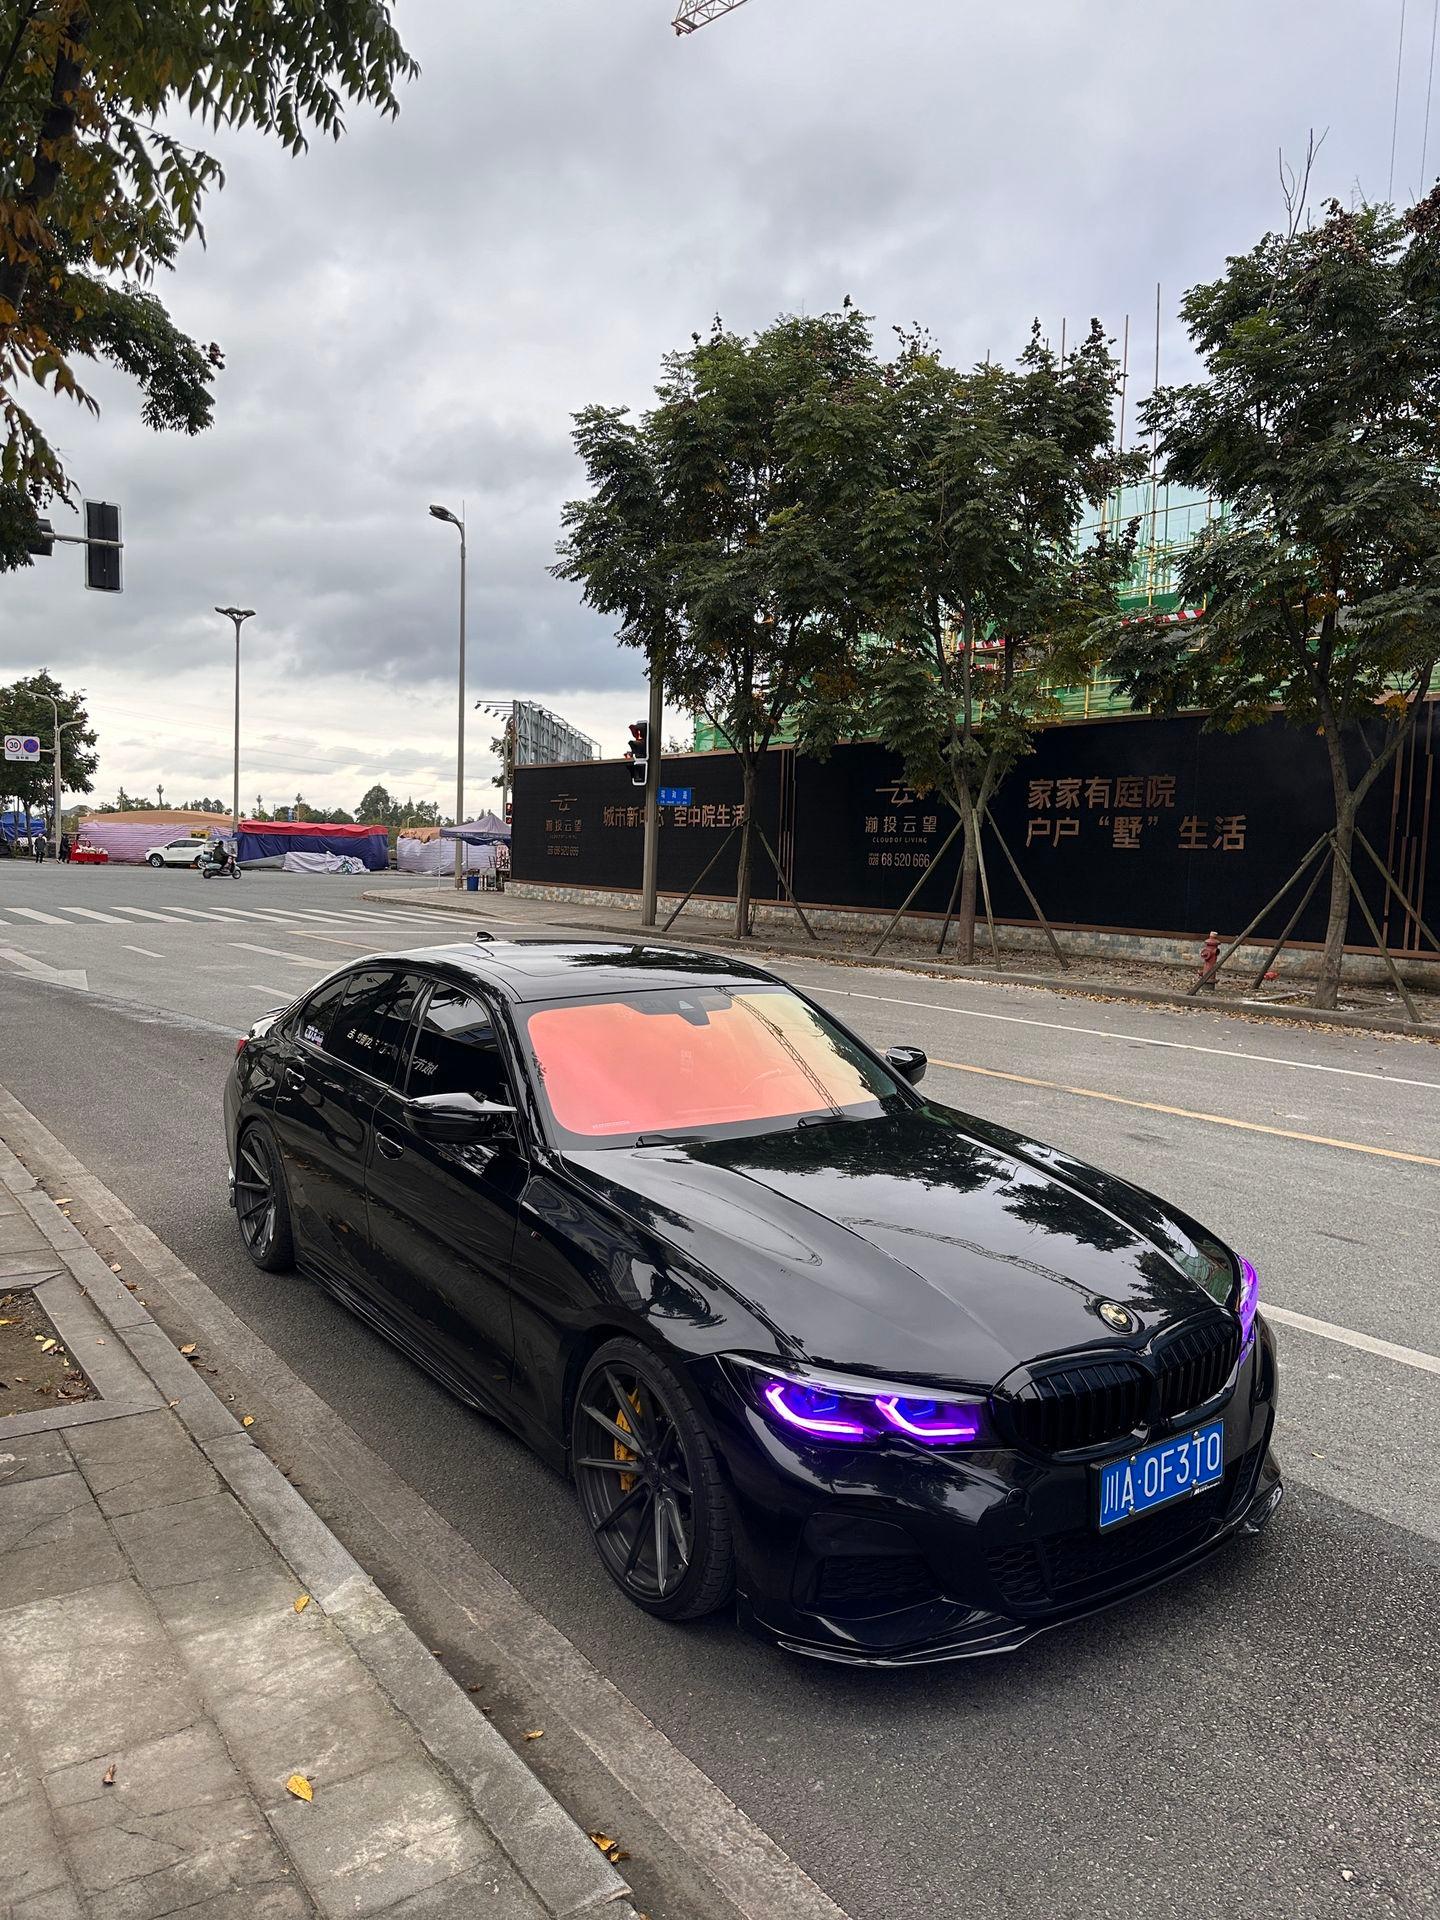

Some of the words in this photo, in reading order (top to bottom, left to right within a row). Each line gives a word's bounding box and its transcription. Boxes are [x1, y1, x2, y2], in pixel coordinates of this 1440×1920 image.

[1027, 774, 1177, 810] 家家有庭院
[673, 803, 745, 828] 空中院生活
[881, 852, 893, 867] 68
[894, 853, 911, 867] 520
[912, 853, 930, 868] 666
